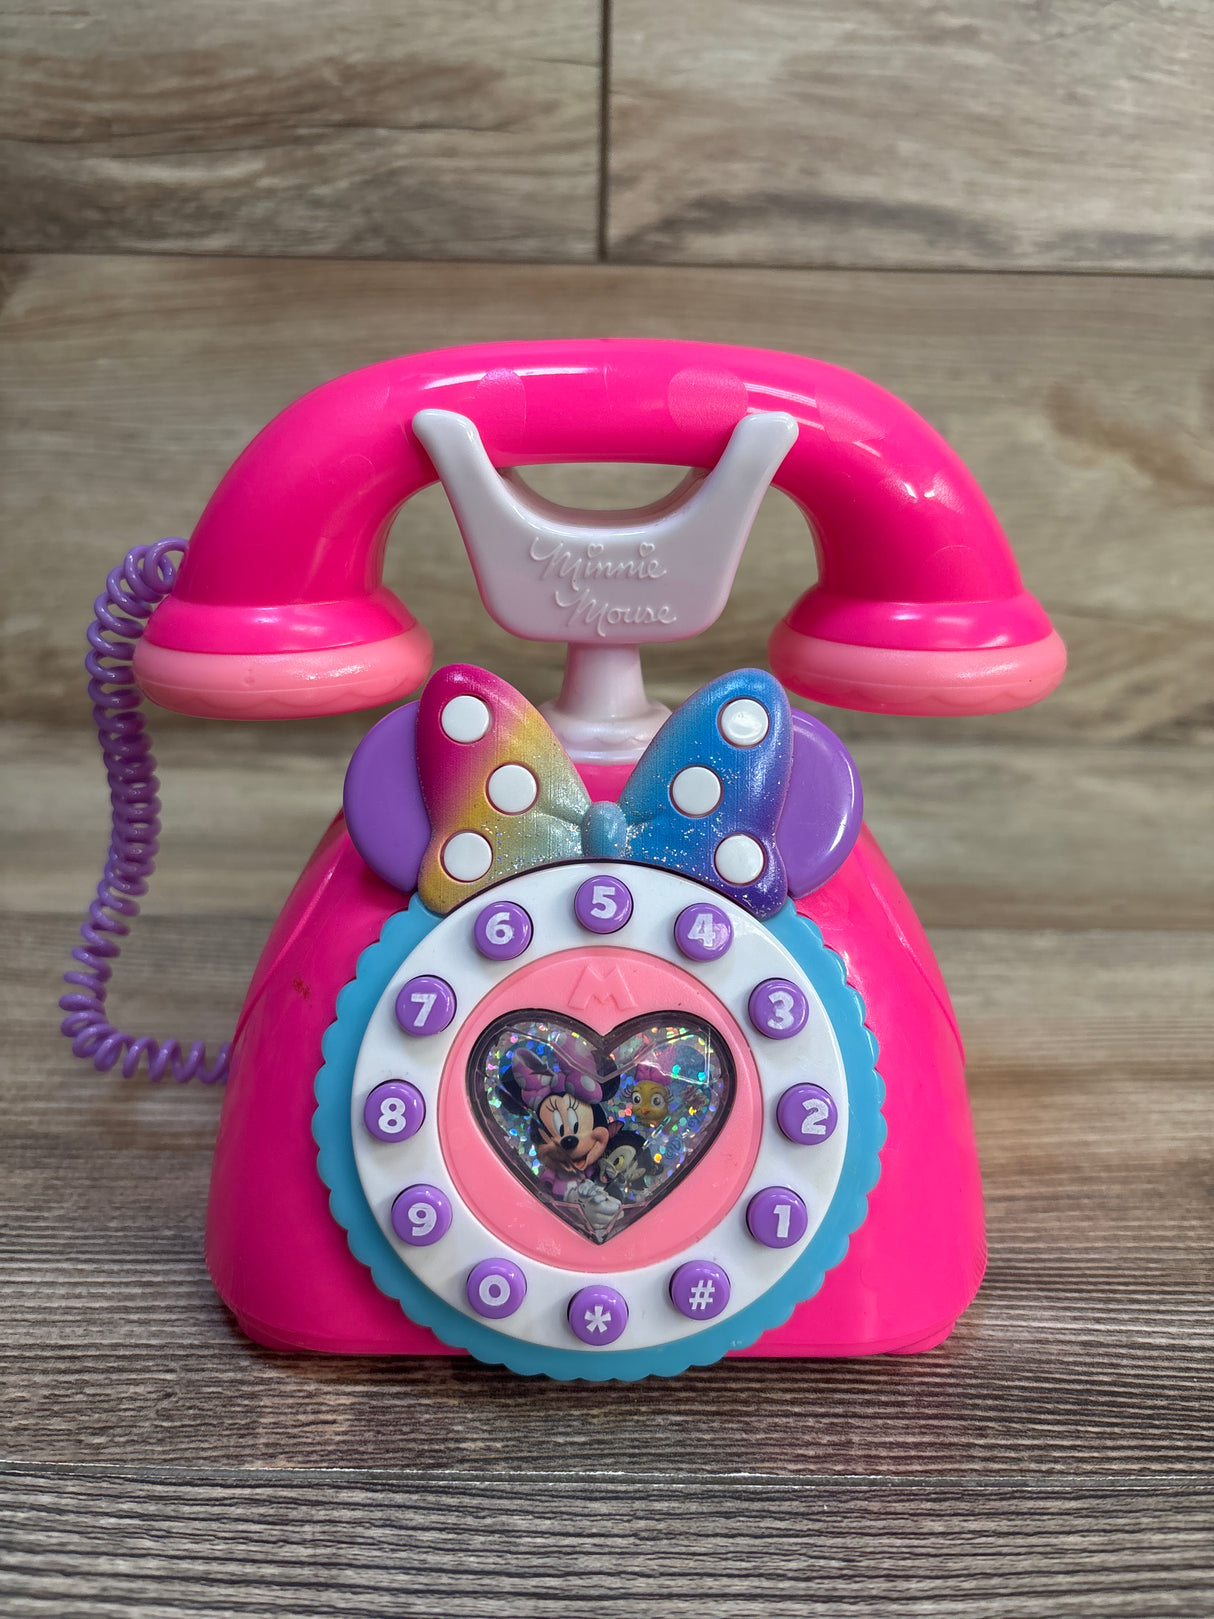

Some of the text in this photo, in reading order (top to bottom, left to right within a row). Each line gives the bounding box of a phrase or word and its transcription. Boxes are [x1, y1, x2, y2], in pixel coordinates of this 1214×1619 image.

[530, 536, 667, 591] Minnie
[555, 588, 677, 637] Mouse
[590, 885, 618, 920] 5
[485, 911, 514, 945] 6
[687, 913, 716, 947] 4
[410, 993, 438, 1027] 7
[767, 990, 795, 1030] 3
[378, 1097, 407, 1134] 8
[801, 1098, 829, 1135] 2
[407, 1202, 437, 1237] 9
[773, 1204, 791, 1238] 1
[688, 1279, 716, 1310] #
